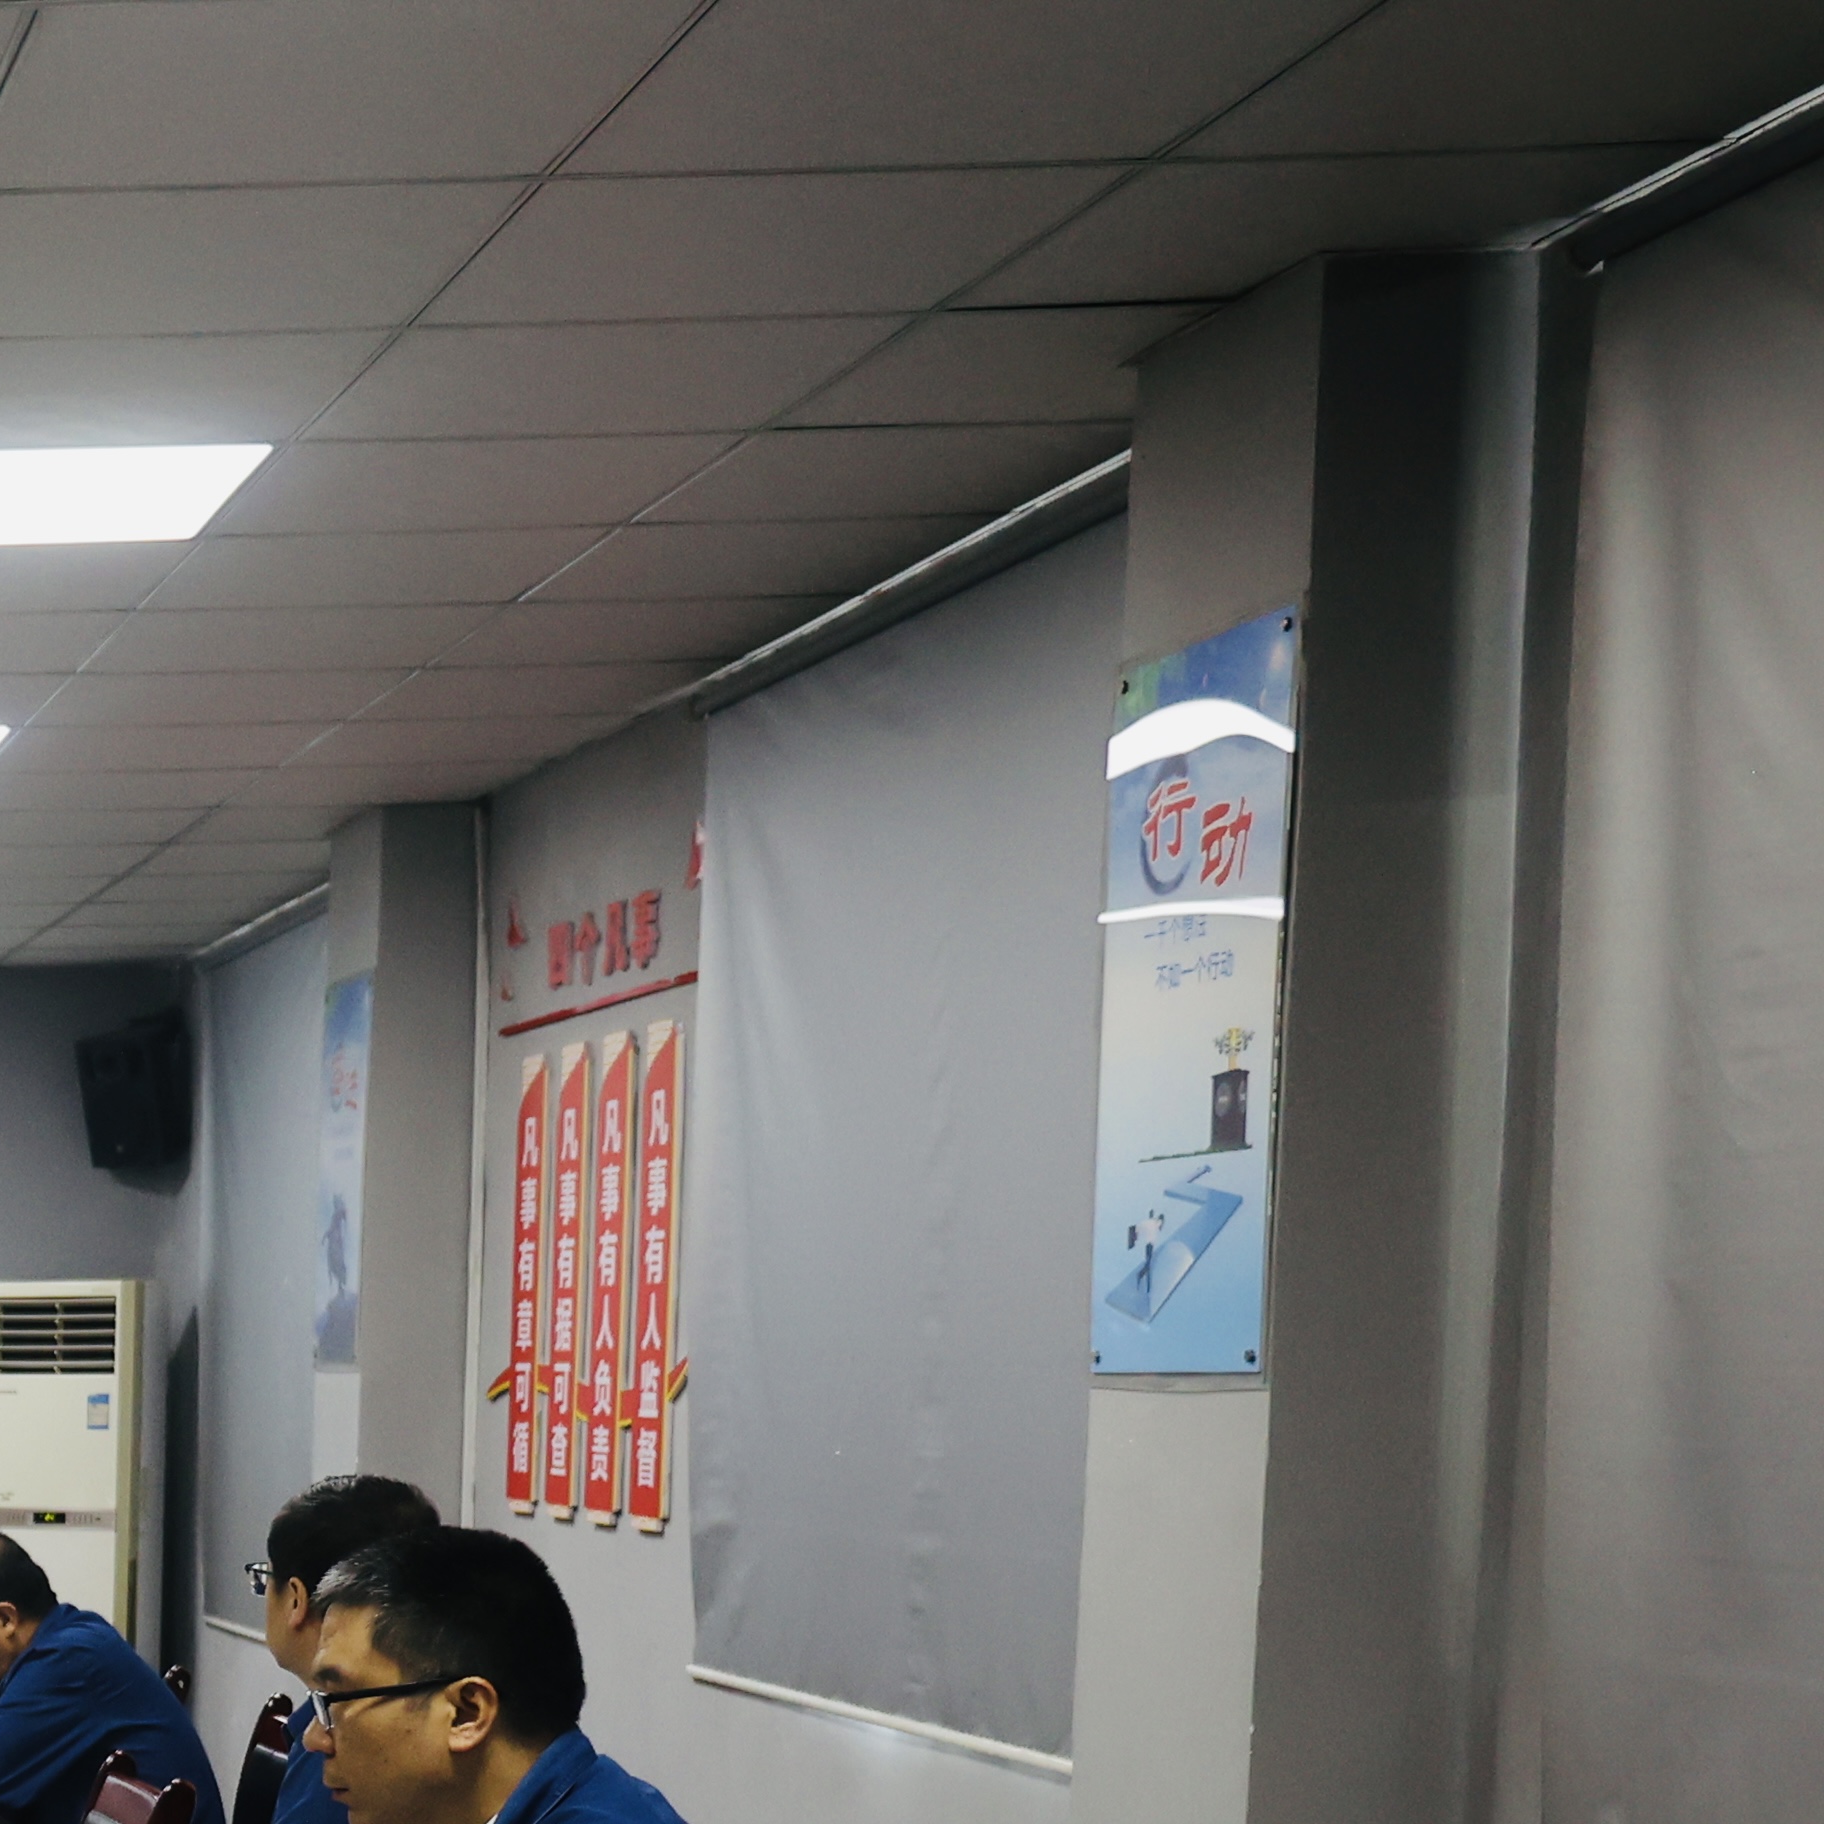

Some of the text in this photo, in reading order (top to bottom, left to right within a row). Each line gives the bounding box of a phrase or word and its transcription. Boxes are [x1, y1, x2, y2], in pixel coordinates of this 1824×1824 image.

[547, 889, 663, 991] 四个凡事
[1143, 780, 1254, 888] 行动
[510, 1115, 540, 1476] 凡事有章可循
[548, 1107, 579, 1481] 凡事有据可查
[588, 1097, 621, 1484] 凡事有人负责
[635, 1087, 670, 1490] 凡事有人监督
